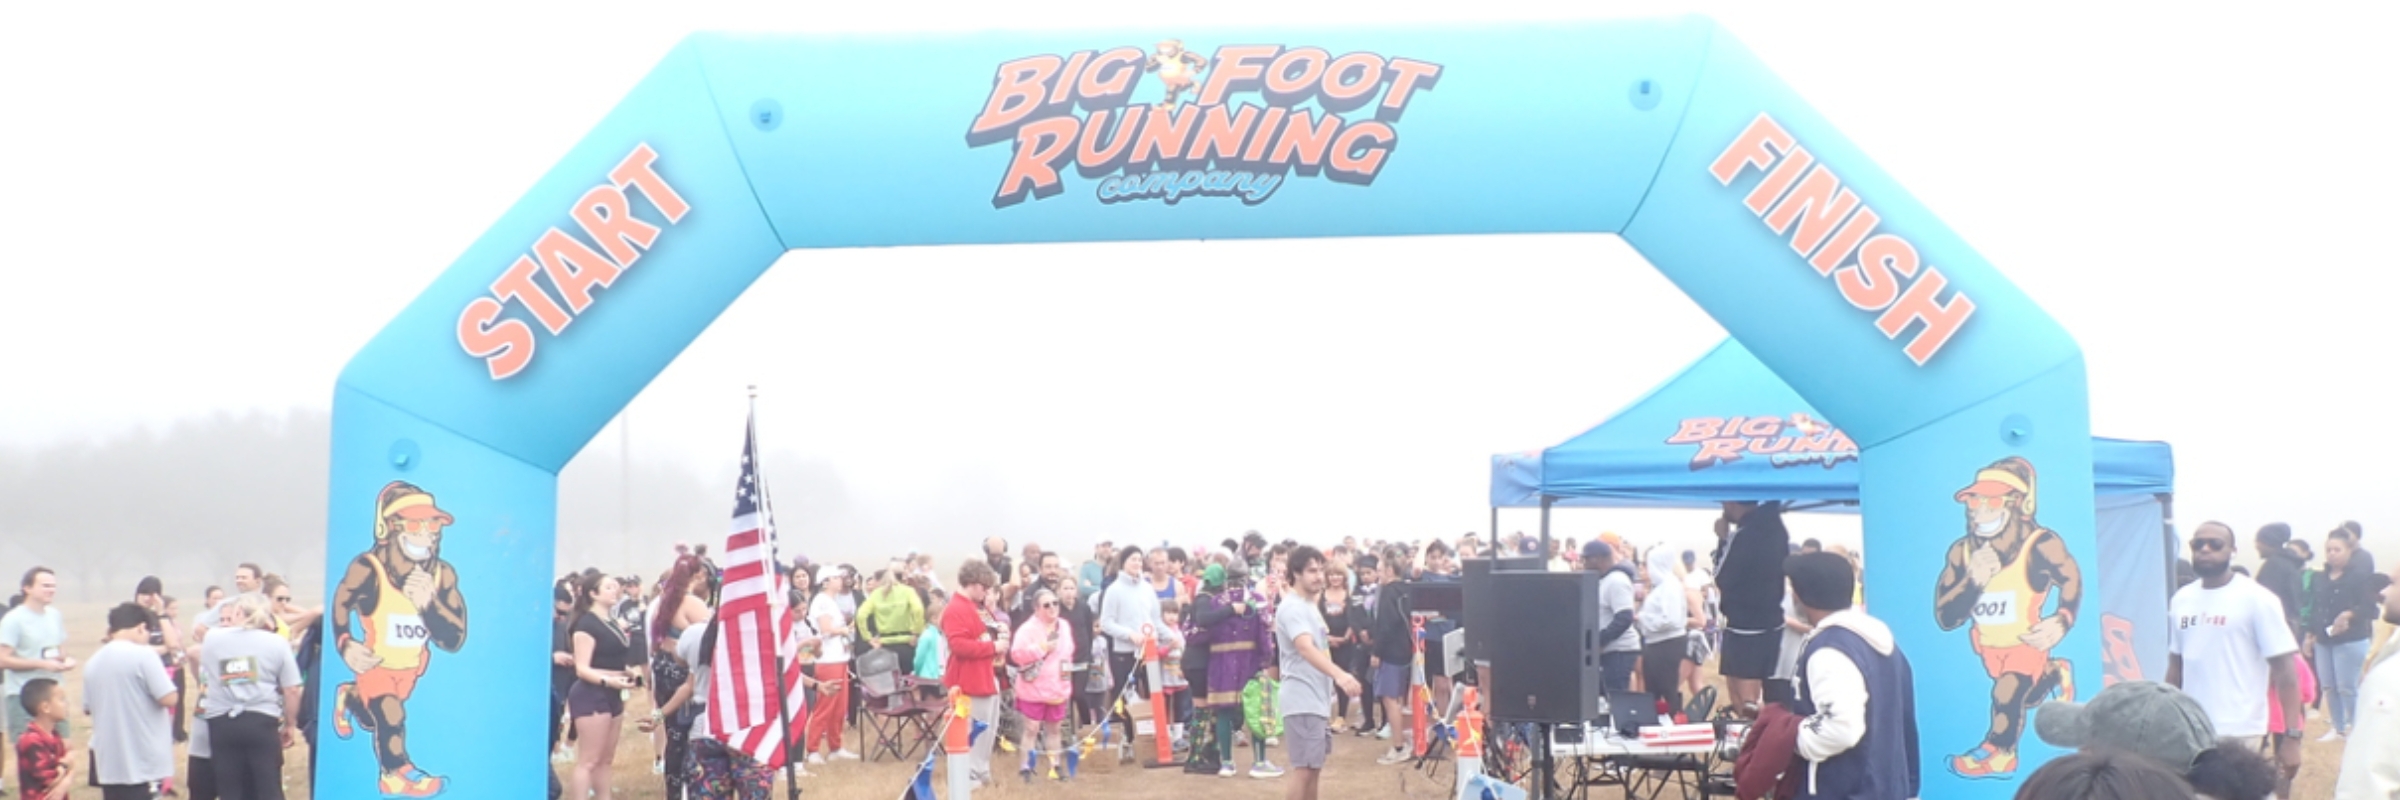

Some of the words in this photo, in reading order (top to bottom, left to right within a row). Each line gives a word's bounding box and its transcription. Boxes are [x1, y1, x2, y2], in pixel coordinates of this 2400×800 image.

[970, 46, 1146, 138] BIG
[1198, 44, 1441, 114] FOOT
[996, 102, 1396, 203] RUNNING
[1098, 168, 1283, 203] company
[456, 140, 692, 381] START
[1707, 110, 1977, 368] FINISH
[1666, 415, 1784, 444] BIG
